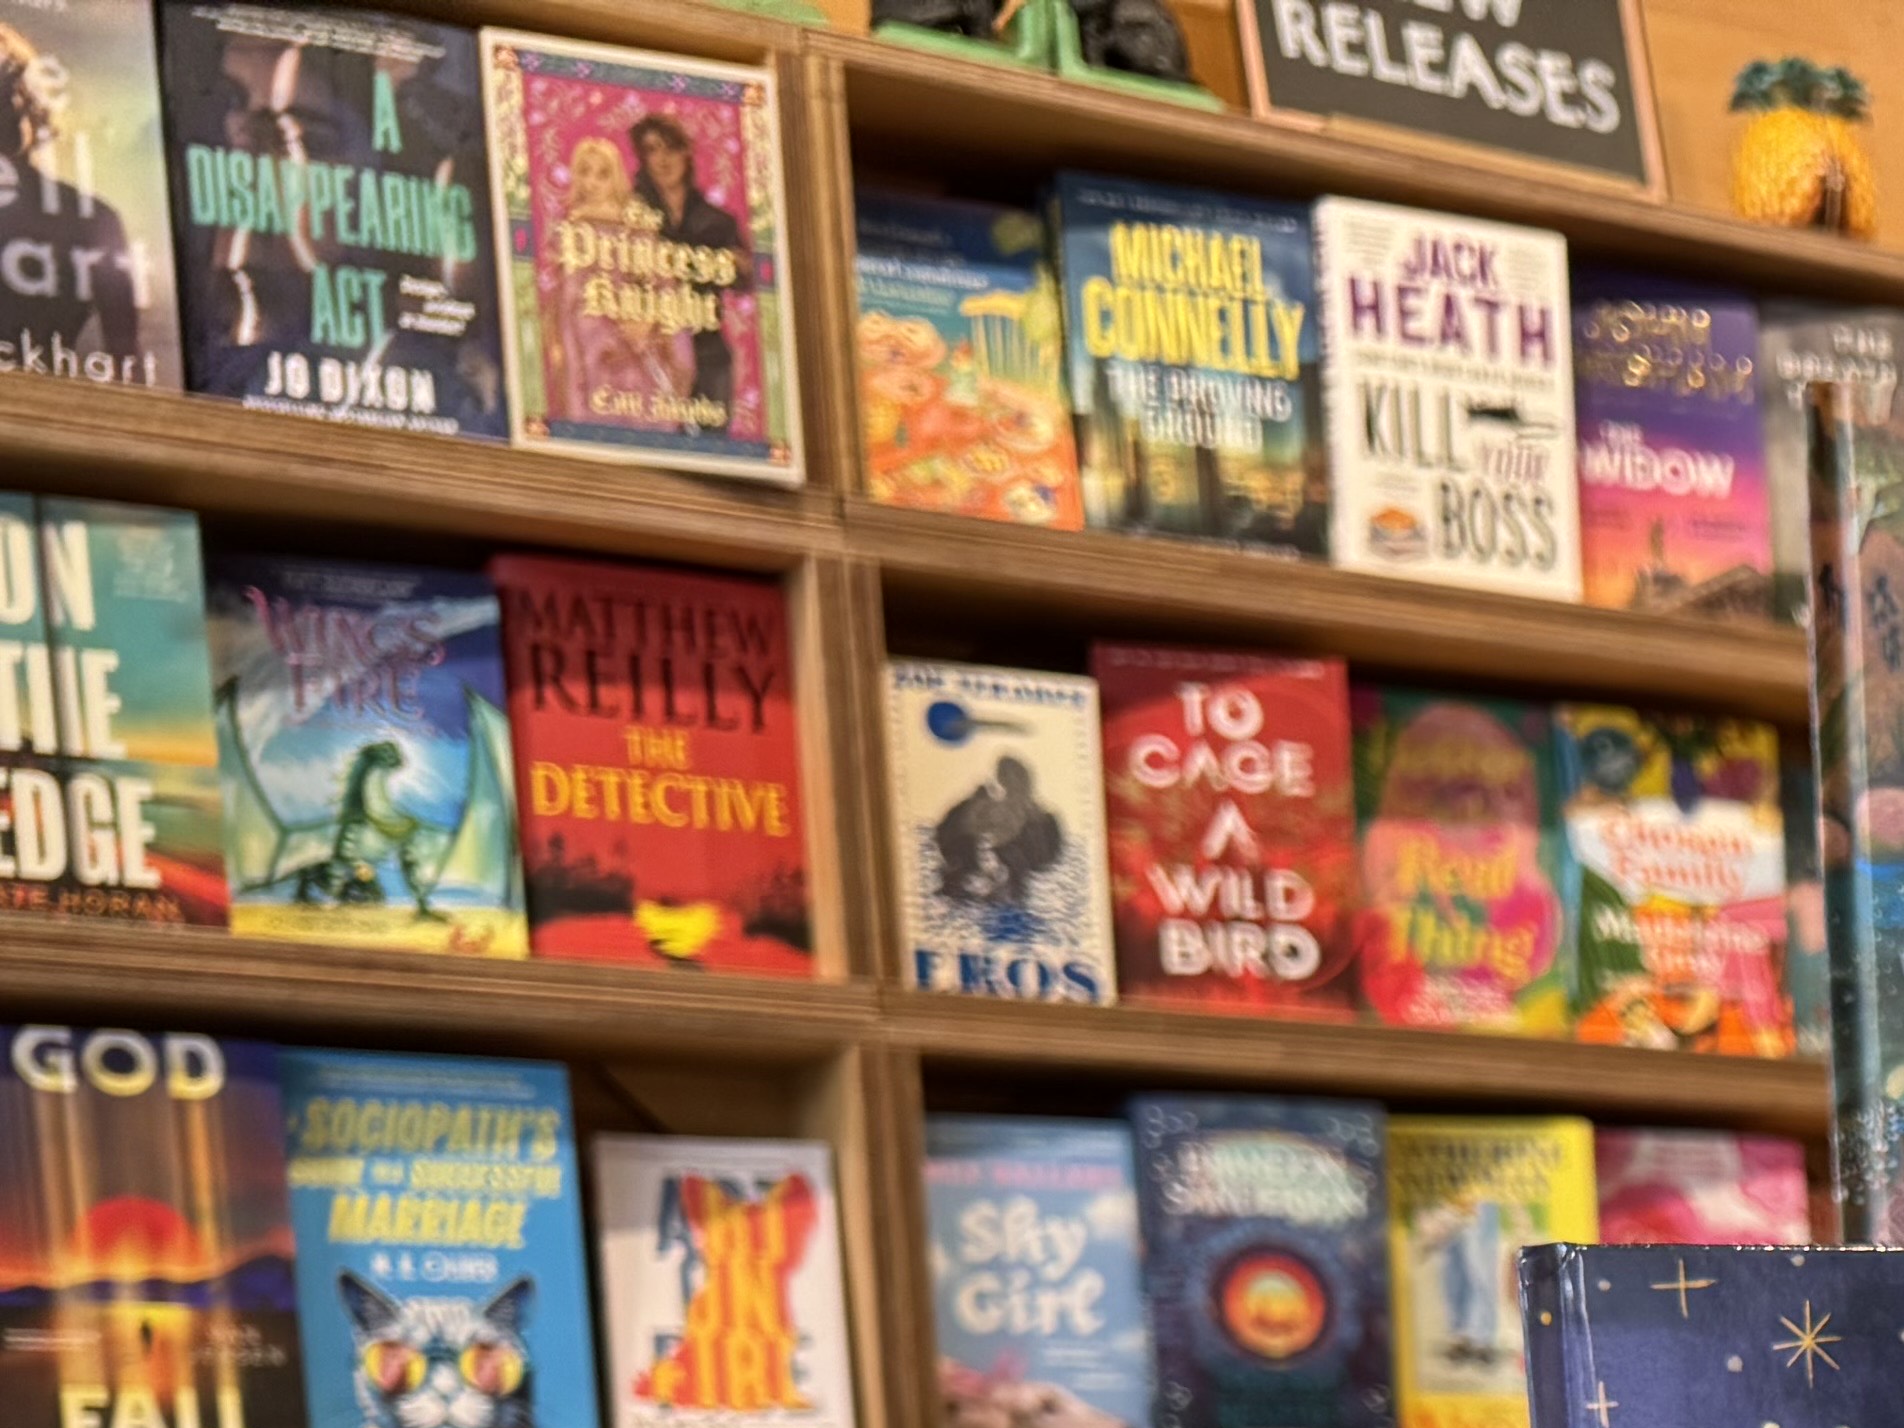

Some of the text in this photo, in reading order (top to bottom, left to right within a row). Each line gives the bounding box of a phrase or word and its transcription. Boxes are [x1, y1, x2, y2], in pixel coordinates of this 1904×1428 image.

[188, 146, 477, 262] DISAPPEARING
[1109, 221, 1262, 291] MICHAEL
[311, 264, 389, 349] ACT
[1083, 280, 1304, 380] CONNELLY
[266, 354, 435, 413] JO DIXON
[532, 643, 776, 735] REILLY
[532, 763, 790, 837] DETECTIVE
